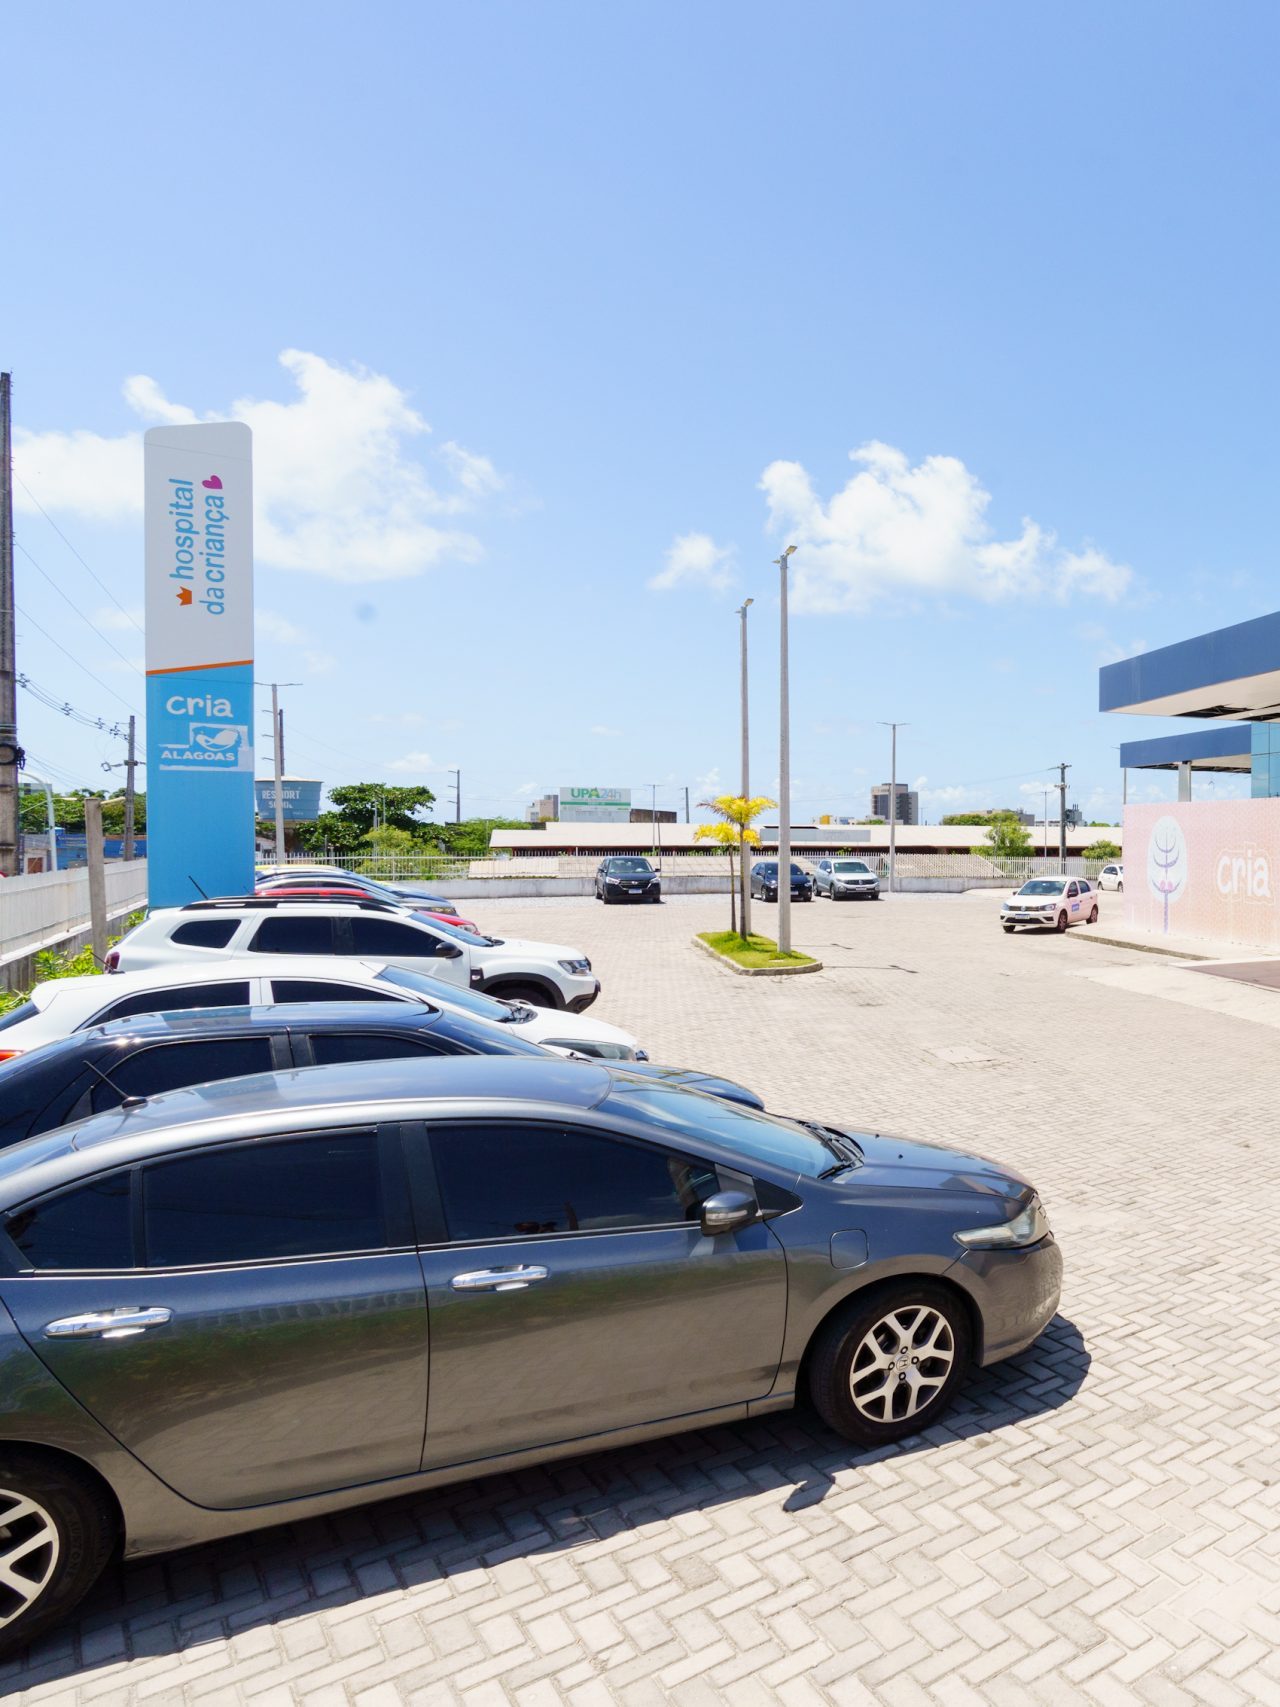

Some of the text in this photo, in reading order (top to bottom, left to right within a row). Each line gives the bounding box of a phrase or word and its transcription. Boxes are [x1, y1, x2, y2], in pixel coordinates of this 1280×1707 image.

[168, 478, 200, 580] hospital
[199, 495, 230, 615] da criança
[166, 694, 234, 718] cria
[161, 750, 235, 761] ALAGOAS
[571, 787, 600, 798] UPA
[1216, 849, 1271, 897] cria
